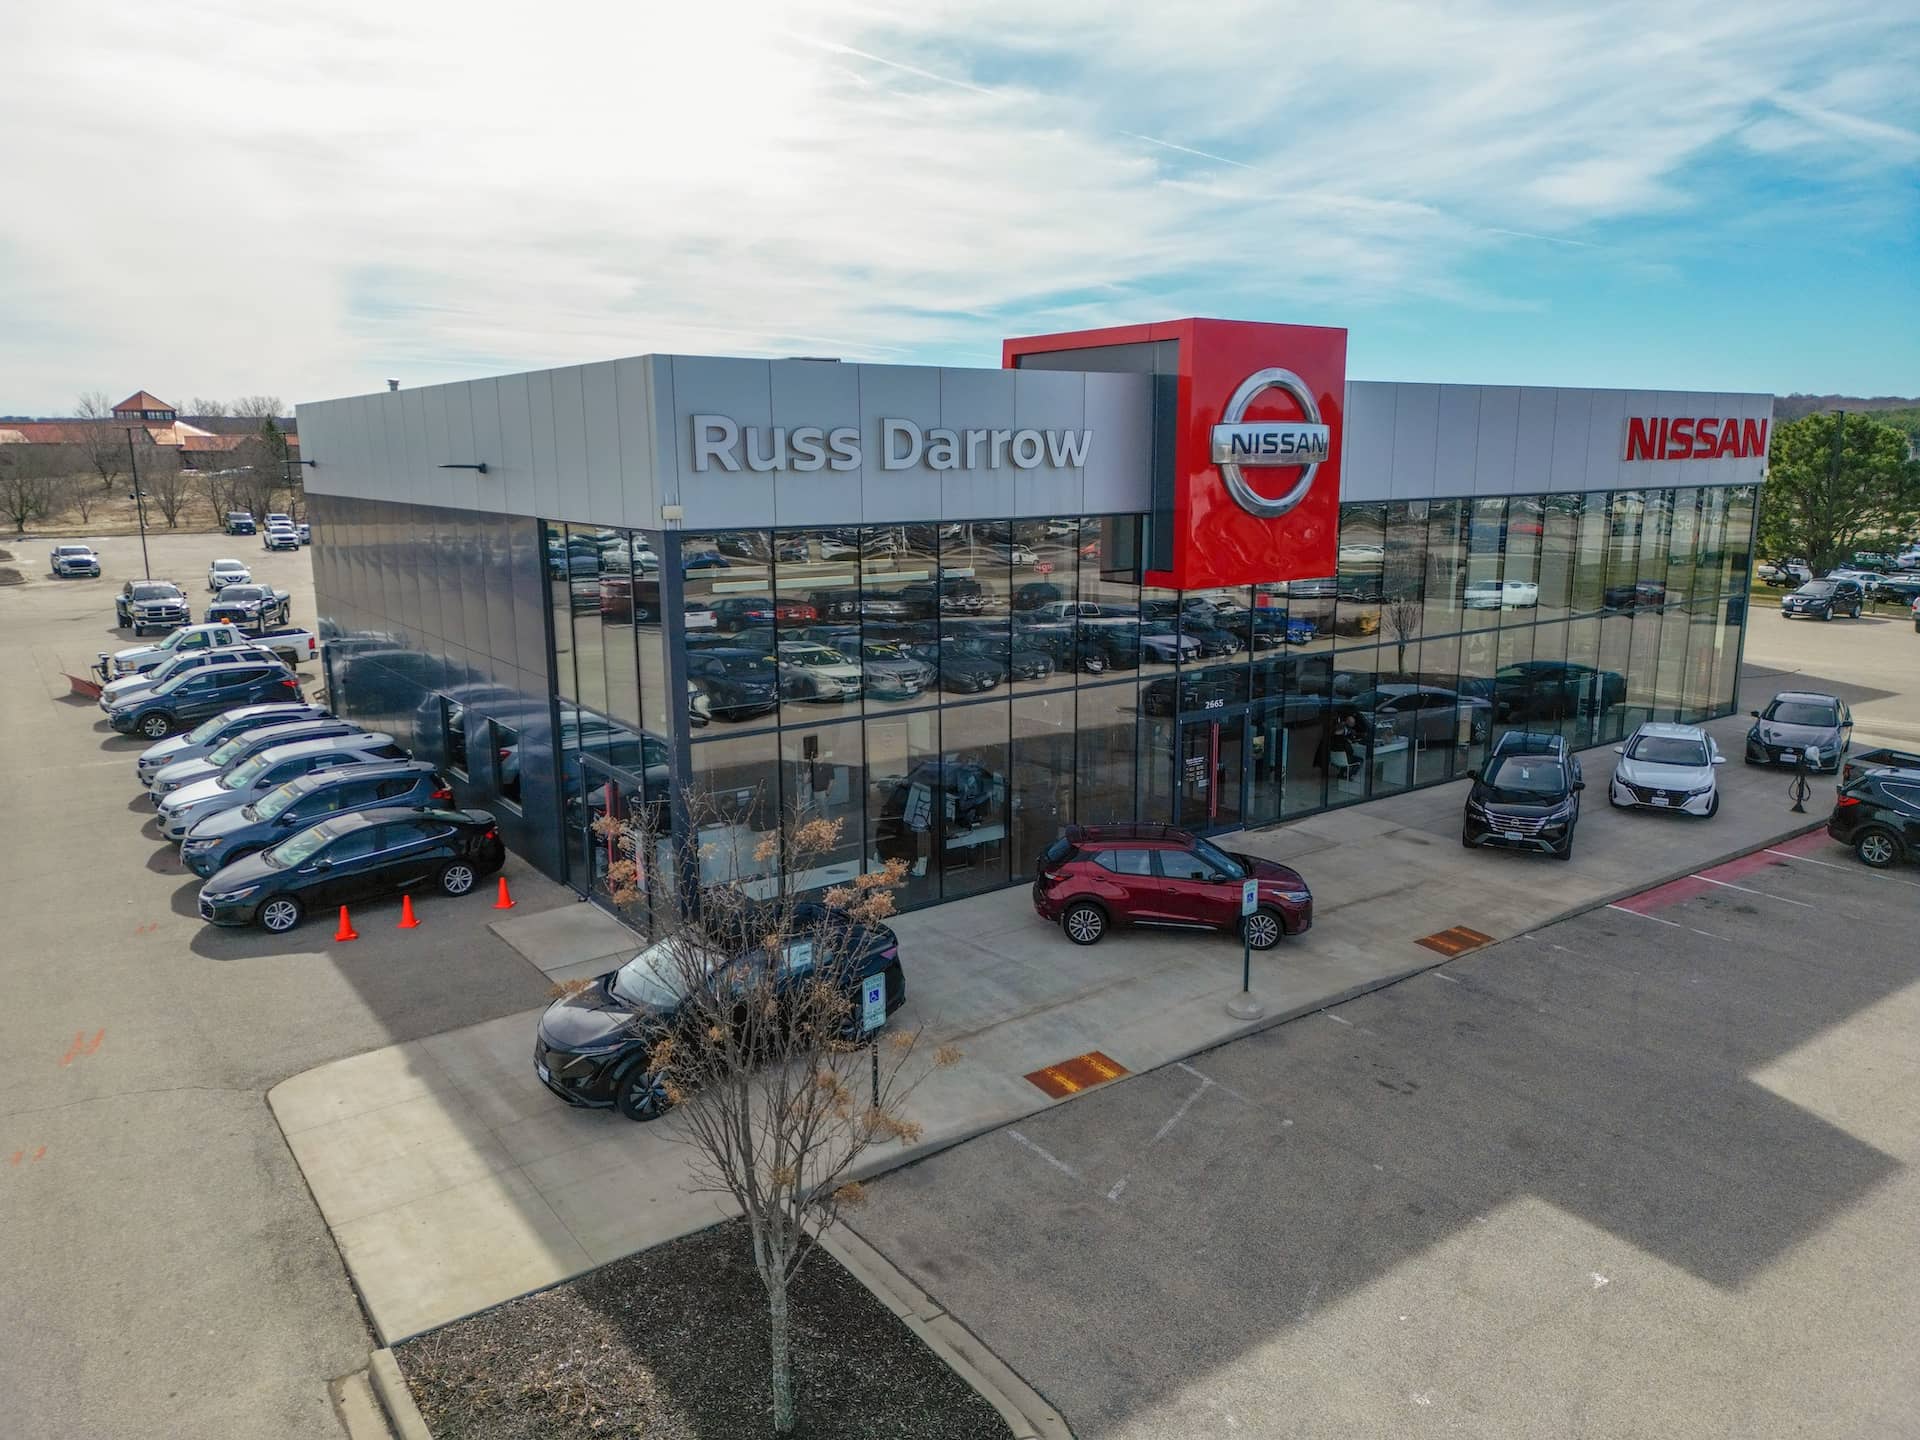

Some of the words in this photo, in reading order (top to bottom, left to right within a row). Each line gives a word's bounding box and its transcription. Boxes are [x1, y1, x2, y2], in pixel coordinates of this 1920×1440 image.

[690, 413, 863, 472] Russ
[880, 416, 1094, 471] Darrow
[1231, 432, 1324, 455] NISSAN
[1625, 417, 1768, 461] NISSAN
